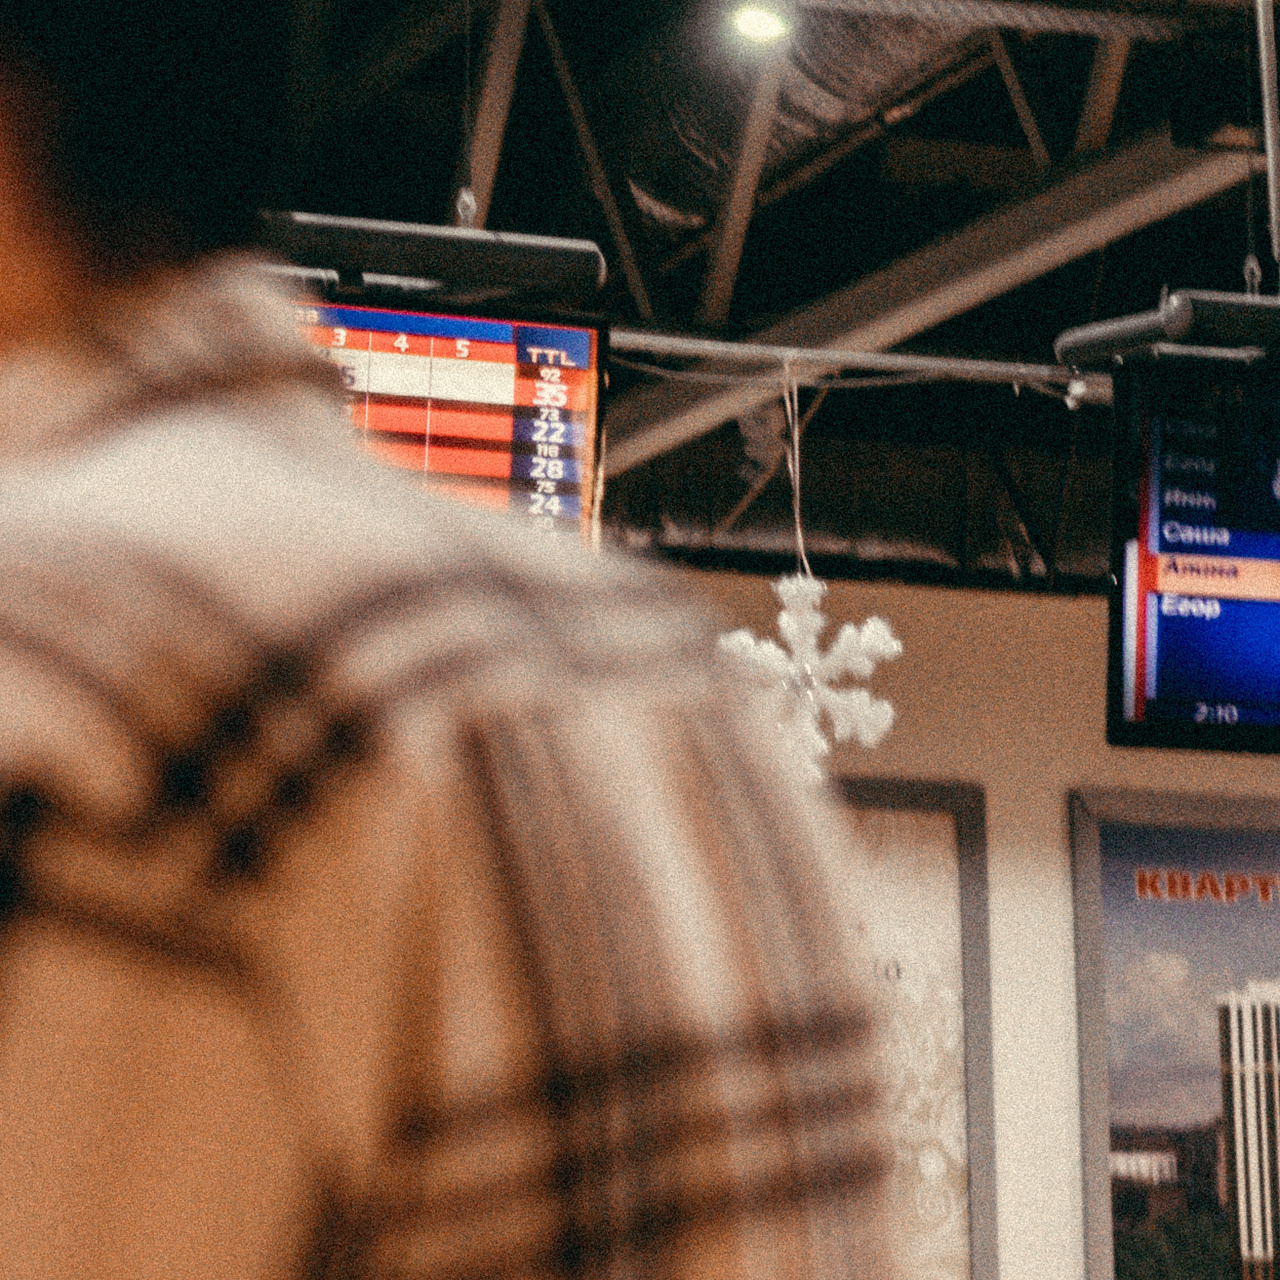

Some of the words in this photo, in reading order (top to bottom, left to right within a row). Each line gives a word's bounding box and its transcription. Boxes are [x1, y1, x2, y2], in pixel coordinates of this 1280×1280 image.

[332, 327, 346, 347] 3
[393, 332, 409, 352] 4
[455, 340, 470, 358] 5
[527, 347, 576, 366] TTL
[531, 421, 566, 444] 22
[530, 457, 564, 479] 28
[529, 492, 562, 515] 24
